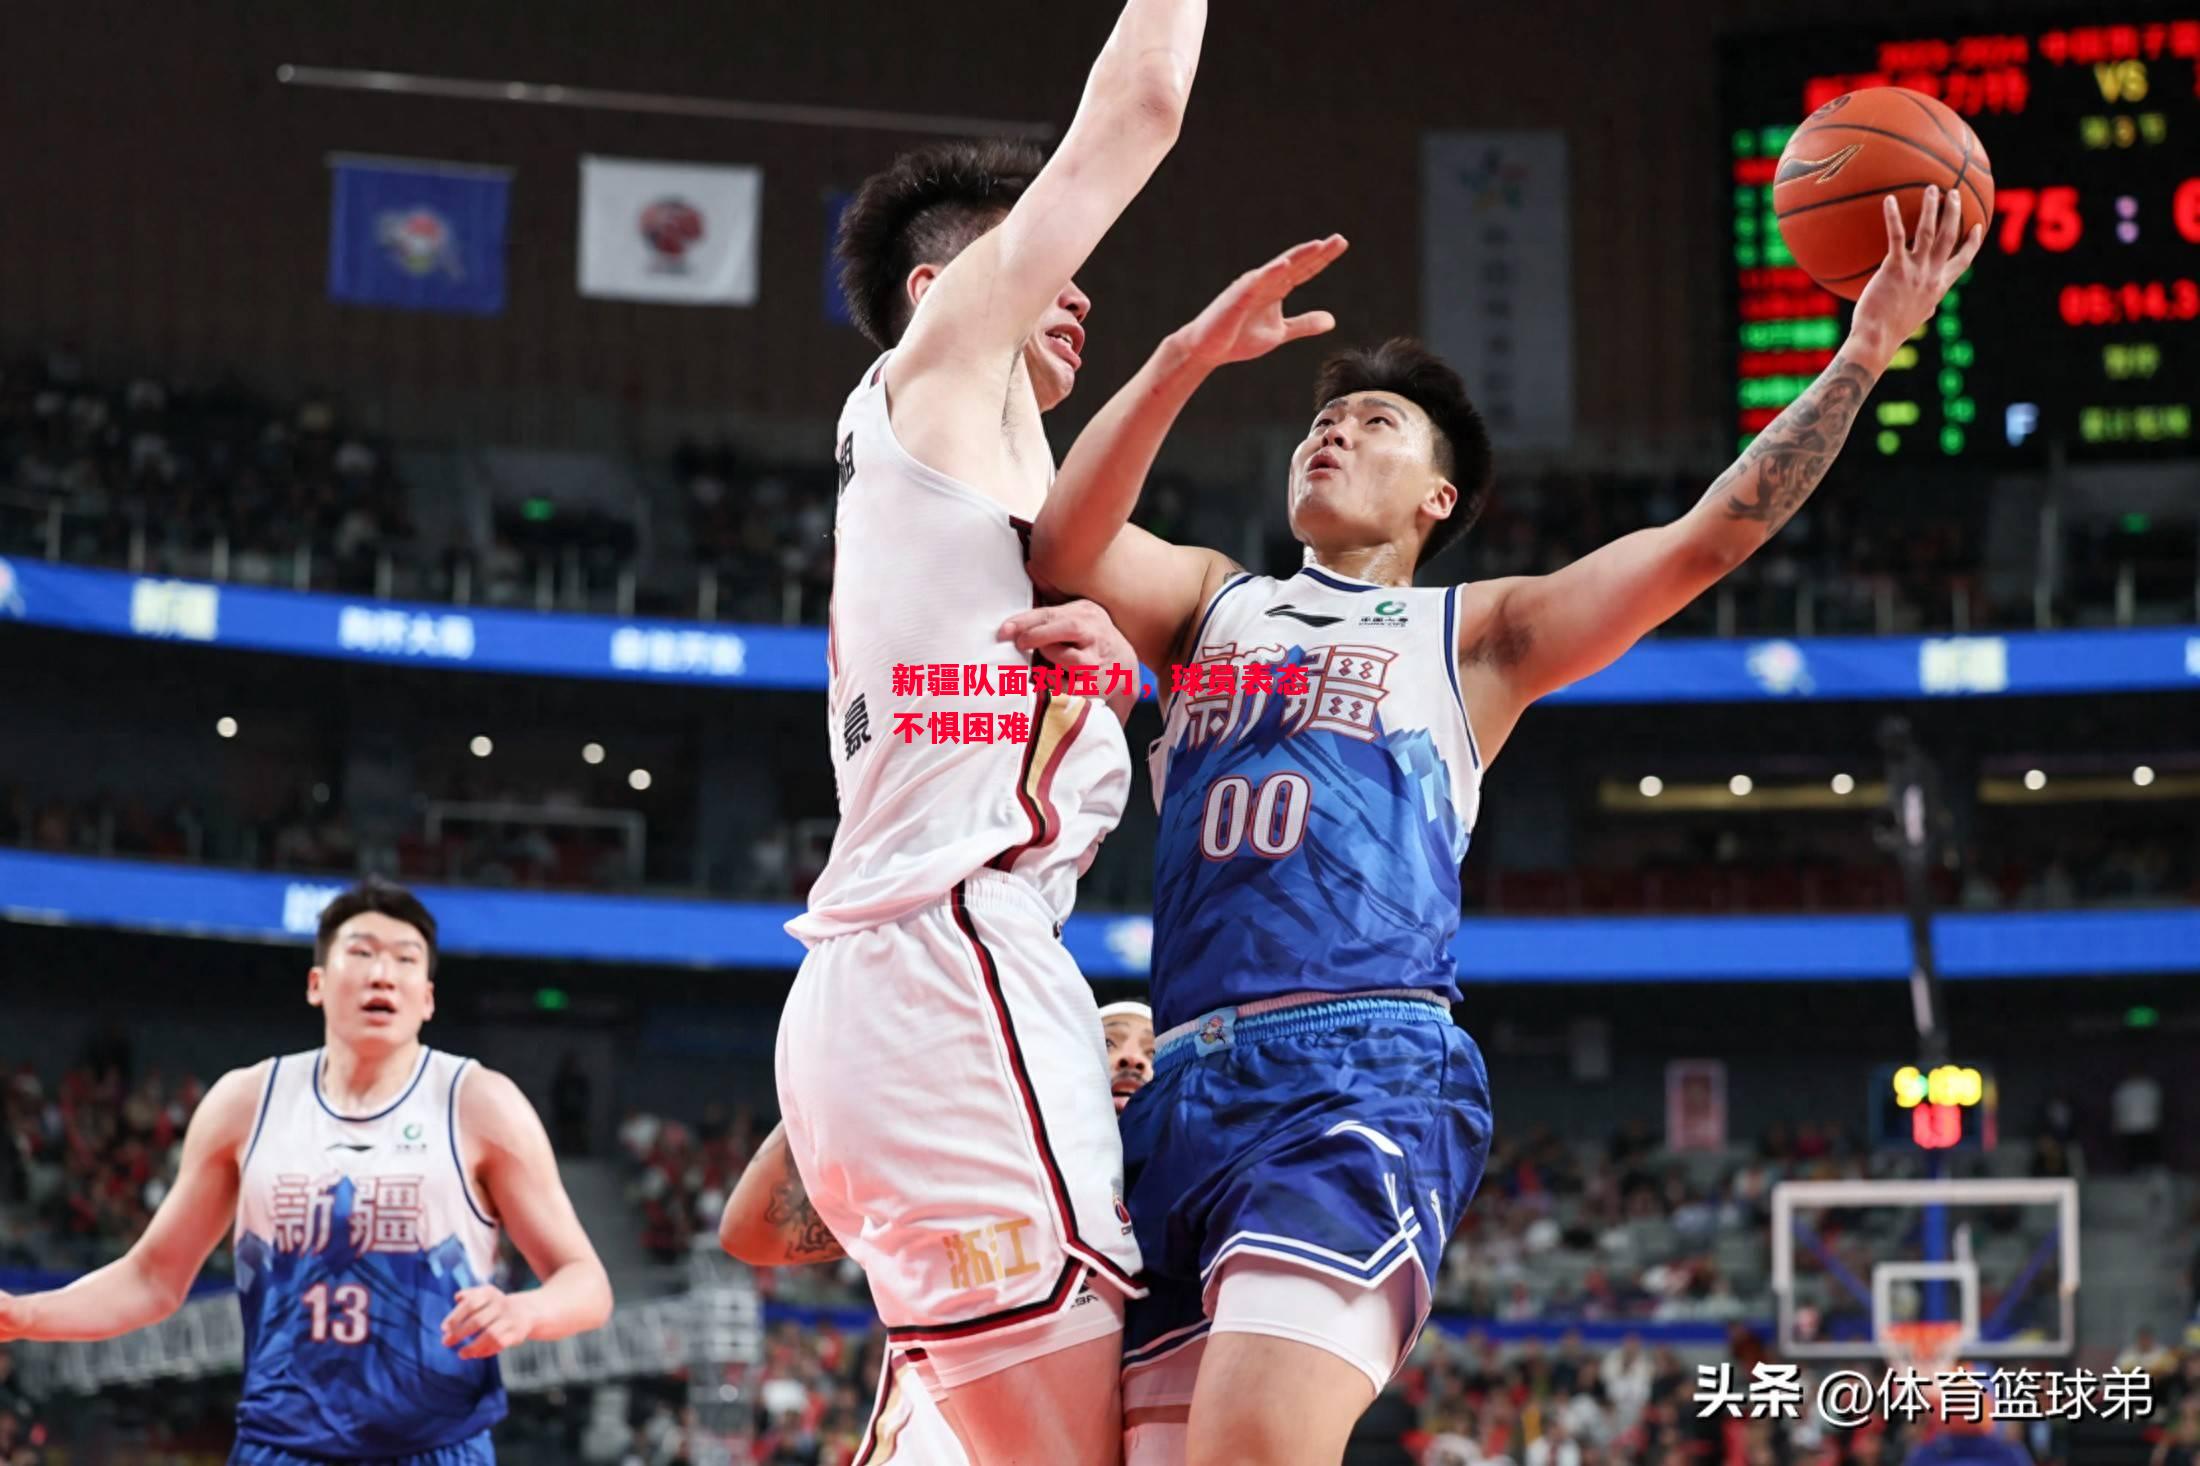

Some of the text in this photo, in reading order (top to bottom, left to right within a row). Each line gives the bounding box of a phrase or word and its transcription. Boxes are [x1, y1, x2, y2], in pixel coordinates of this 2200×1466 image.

[2094, 60, 2148, 103] VS
[1996, 184, 2083, 253] 75
[1201, 770, 1312, 862] 00
[272, 1169, 424, 1257] 新疆
[942, 1218, 1041, 1289] 浙江
[302, 1283, 371, 1344] 13
